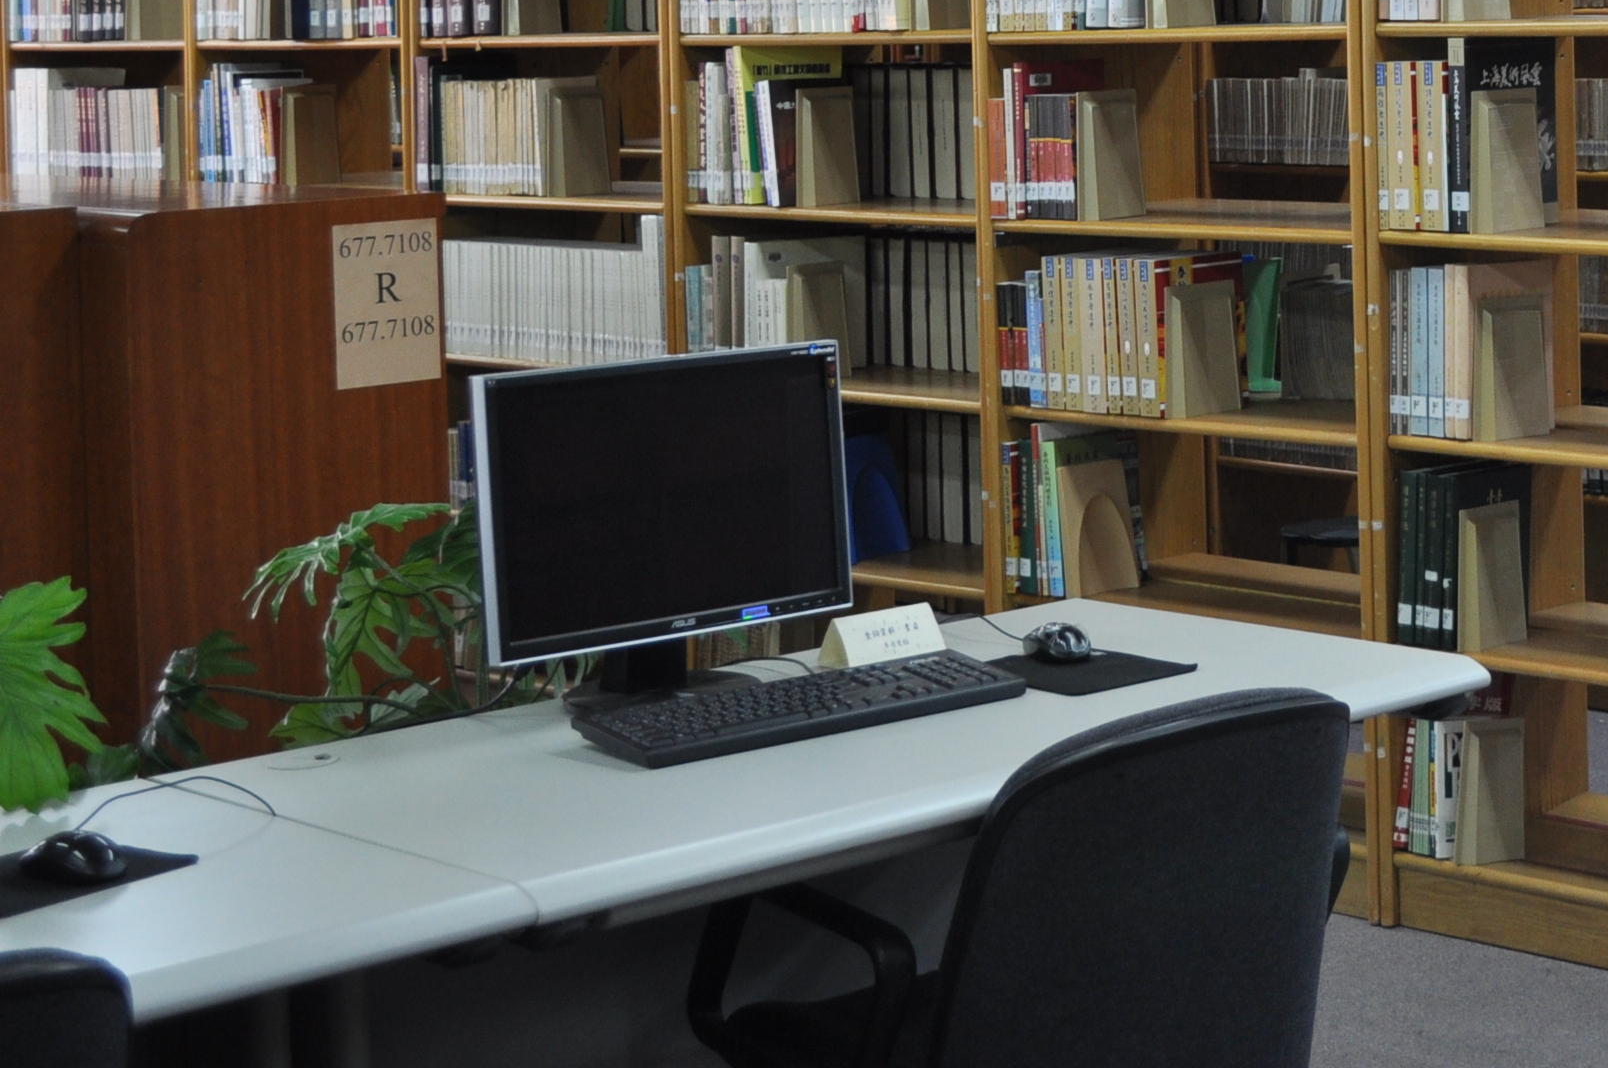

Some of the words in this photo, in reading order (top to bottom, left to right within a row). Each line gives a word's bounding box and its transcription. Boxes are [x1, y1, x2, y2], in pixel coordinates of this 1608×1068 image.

[1479, 61, 1543, 88] 上海美術風雲
[338, 231, 433, 259] 677.7108
[374, 272, 402, 305] R
[341, 314, 435, 344] 677.7108
[671, 617, 697, 630] ASUS
